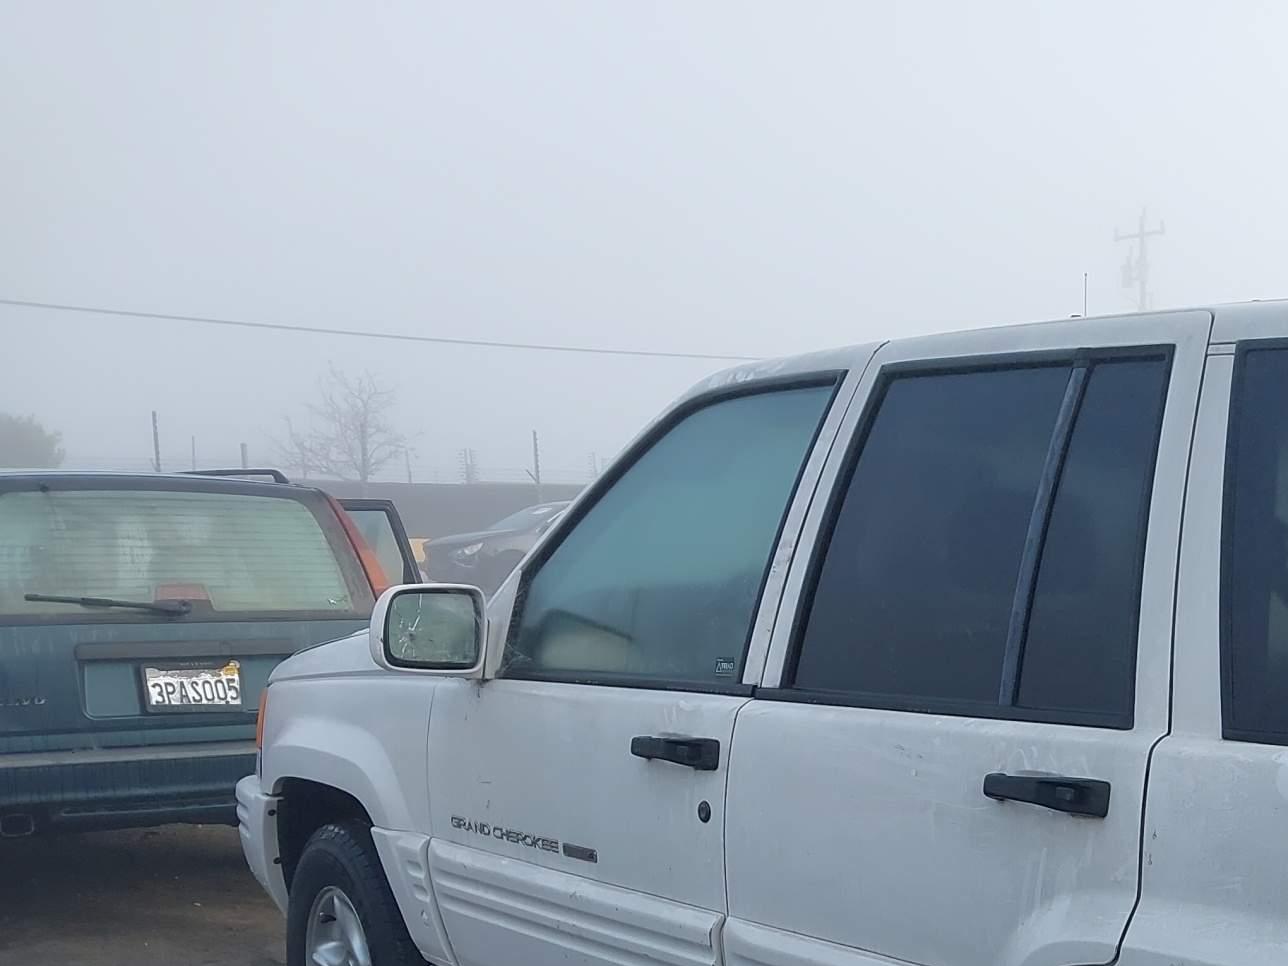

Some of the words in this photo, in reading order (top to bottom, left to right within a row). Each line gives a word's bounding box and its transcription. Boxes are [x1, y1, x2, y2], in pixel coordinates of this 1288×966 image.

[151, 678, 239, 704] 3PAS005
[451, 816, 491, 836] GRAND
[492, 826, 560, 854] CHEROKEE
